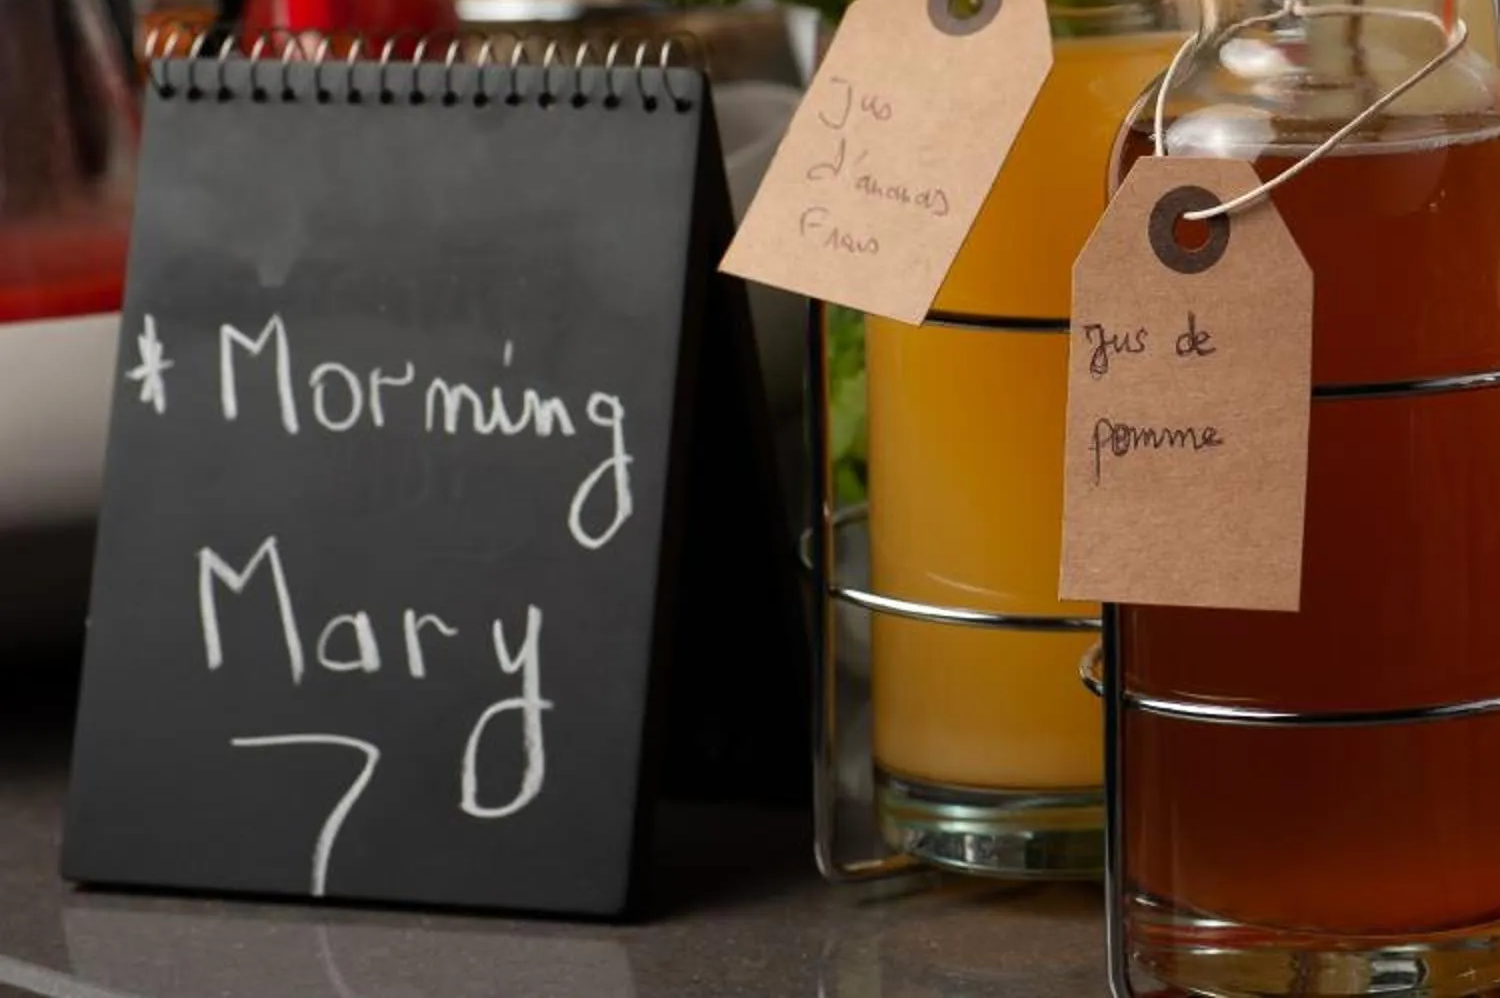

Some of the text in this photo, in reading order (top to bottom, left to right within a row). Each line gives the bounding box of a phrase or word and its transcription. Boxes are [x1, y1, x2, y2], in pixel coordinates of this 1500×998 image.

[818, 75, 893, 130] Jus
[1083, 311, 1218, 379] Jus de
[219, 313, 634, 549] Morning
[1087, 417, 1223, 487] pomme
[199, 535, 554, 819] Mary
